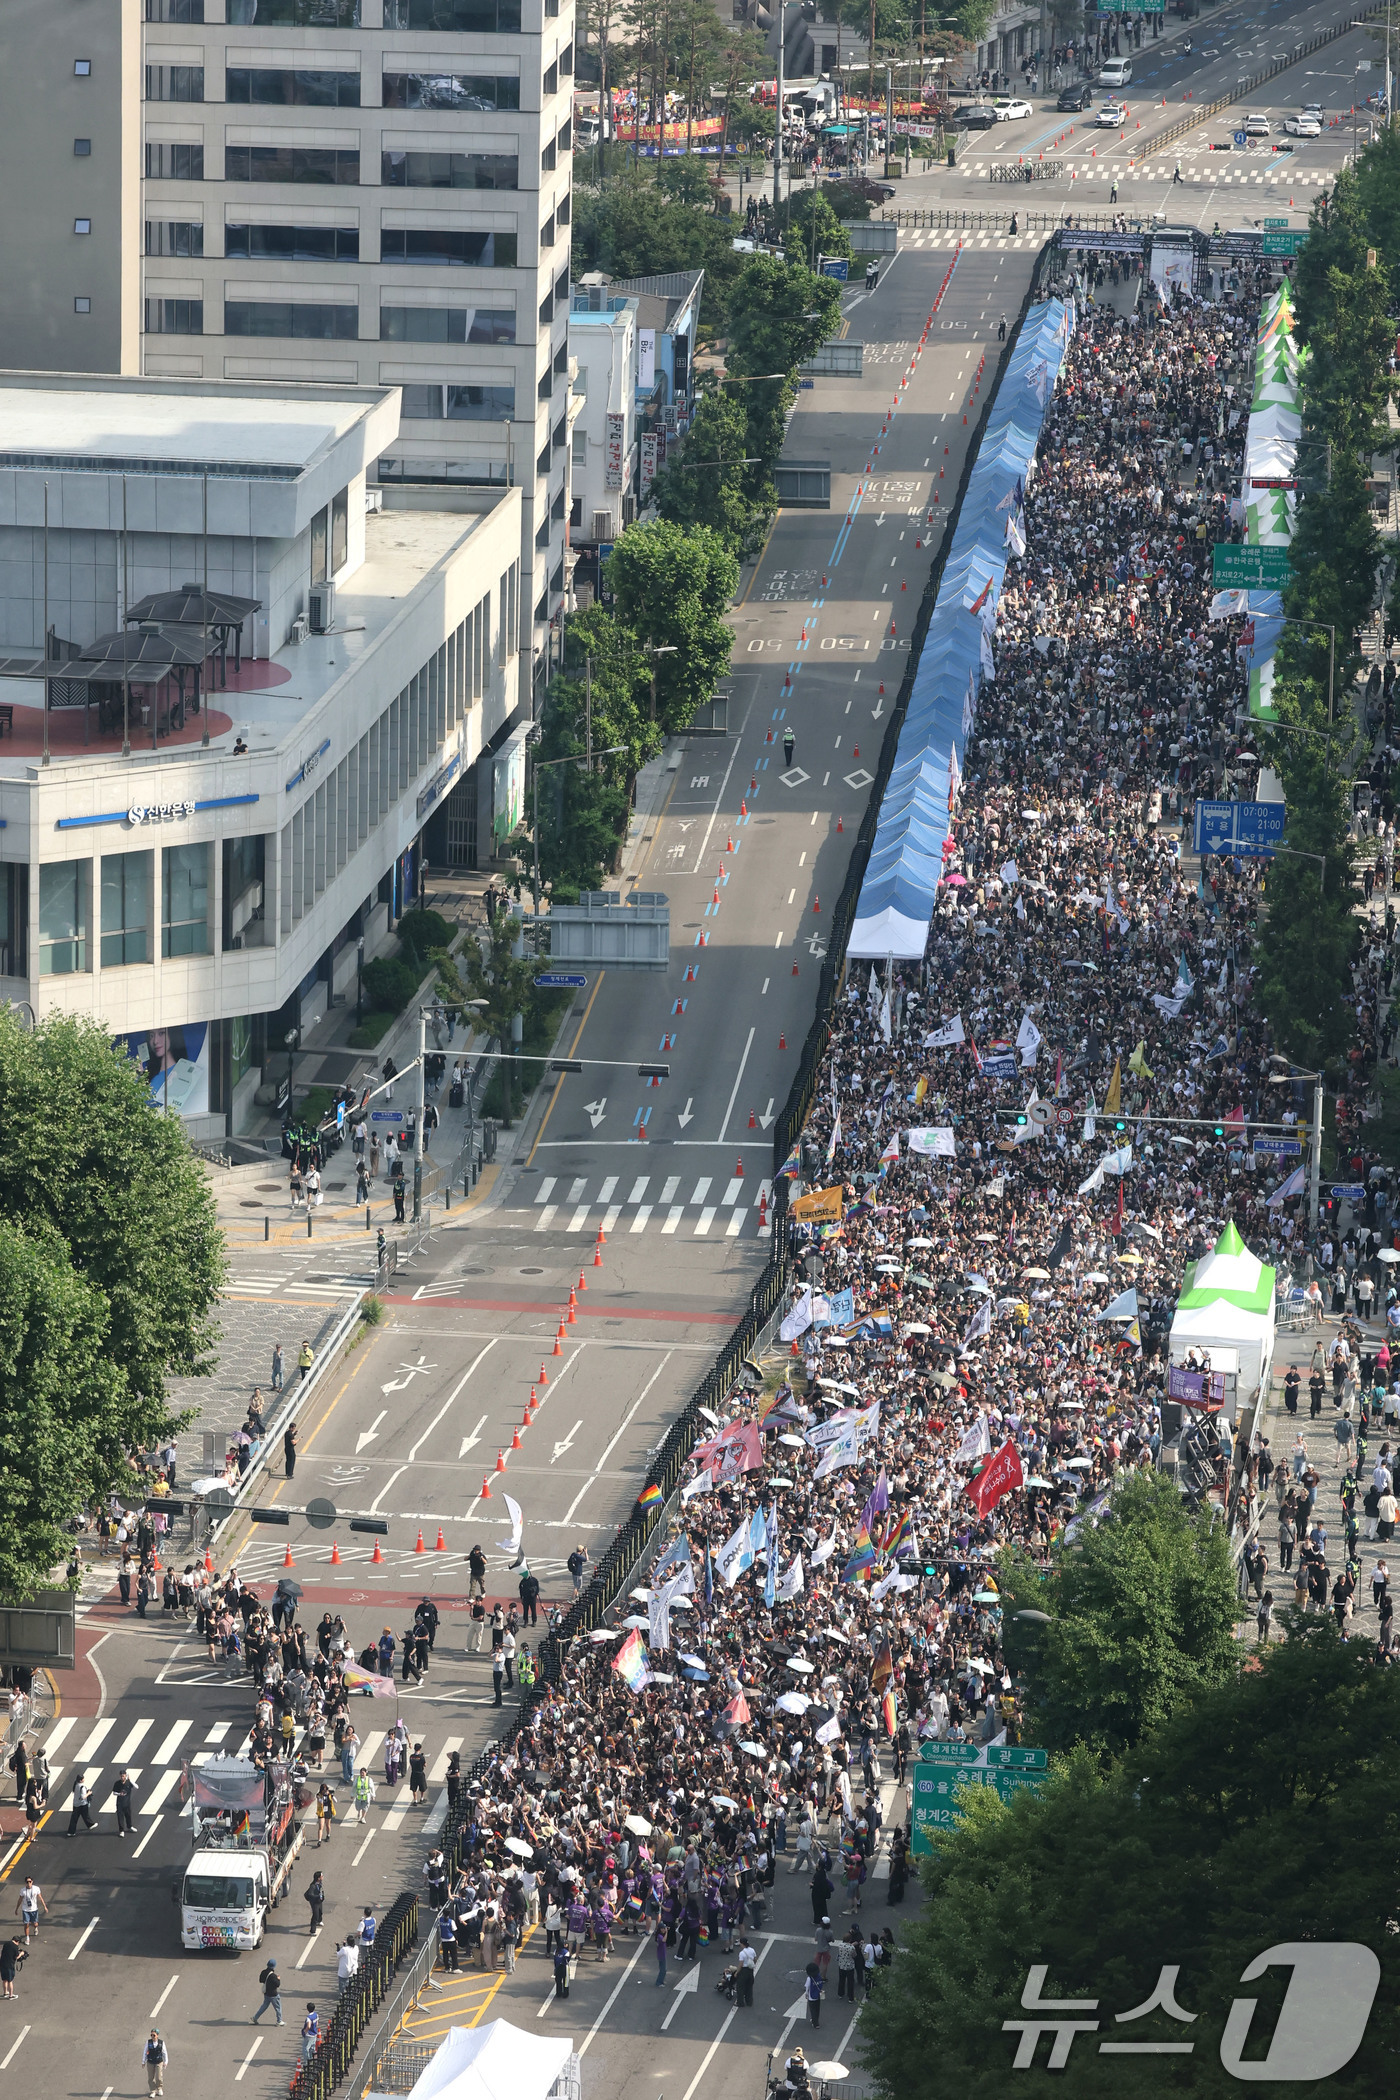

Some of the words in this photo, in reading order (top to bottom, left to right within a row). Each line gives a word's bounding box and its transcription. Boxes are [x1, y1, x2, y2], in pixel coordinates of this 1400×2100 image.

[919, 125, 932, 134] 반대
[941, 320, 968, 330] 50
[641, 341, 649, 354] Biz
[868, 482, 916, 491] 종로1가
[863, 492, 912, 503] 안국동
[1241, 548, 1261, 556] 숭례문
[1233, 557, 1261, 565] 한국은행
[747, 639, 782, 652] 50
[820, 638, 854, 651] 50
[146, 800, 196, 820] 신한은행
[1258, 820, 1280, 830] 21:00
[1060, 1112, 1070, 1120] 50
[932, 1744, 967, 1755] 청계천로
[956, 1769, 997, 1784] 숭례문
[921, 1782, 931, 1791] 60
[202, 1926, 233, 1934] SEOUL
[202, 1936, 233, 1944] QUEER
